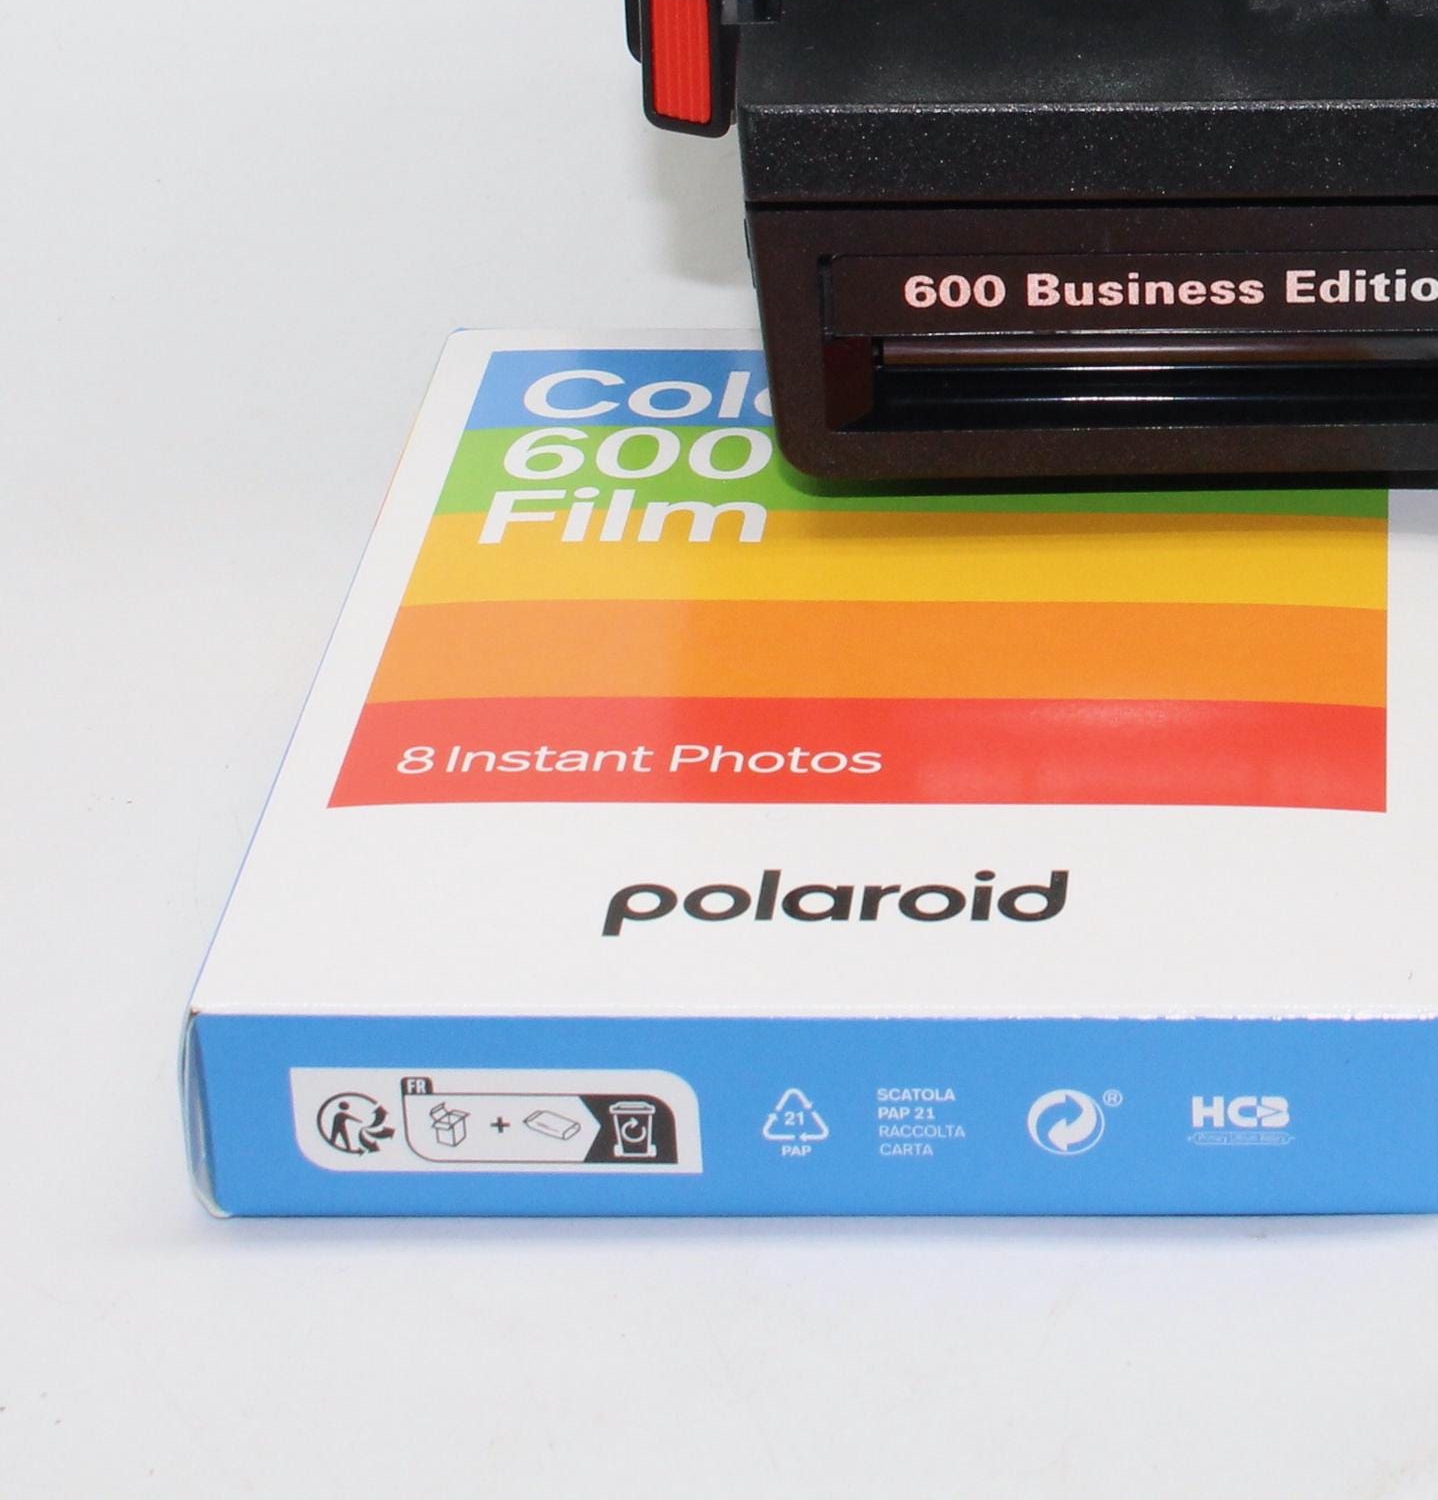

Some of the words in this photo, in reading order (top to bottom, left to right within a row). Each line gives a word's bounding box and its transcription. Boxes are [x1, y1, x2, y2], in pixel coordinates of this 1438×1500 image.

[904, 274, 1006, 308] 600
[1027, 272, 1265, 307] Business
[502, 426, 774, 481] 600
[477, 486, 768, 545] Film
[396, 746, 435, 775] 8
[445, 745, 654, 773] Instant
[669, 744, 882, 774] Photos
[601, 869, 1070, 937] polaroid
[406, 1079, 427, 1094] FR
[876, 1088, 956, 1102] SCATOLA
[784, 1111, 804, 1126] 21
[877, 1106, 911, 1120] PAP
[914, 1106, 935, 1120] 21
[878, 1124, 966, 1139] RACCOLTA
[781, 1145, 812, 1157] PAP
[879, 1142, 934, 1157] CARTA
